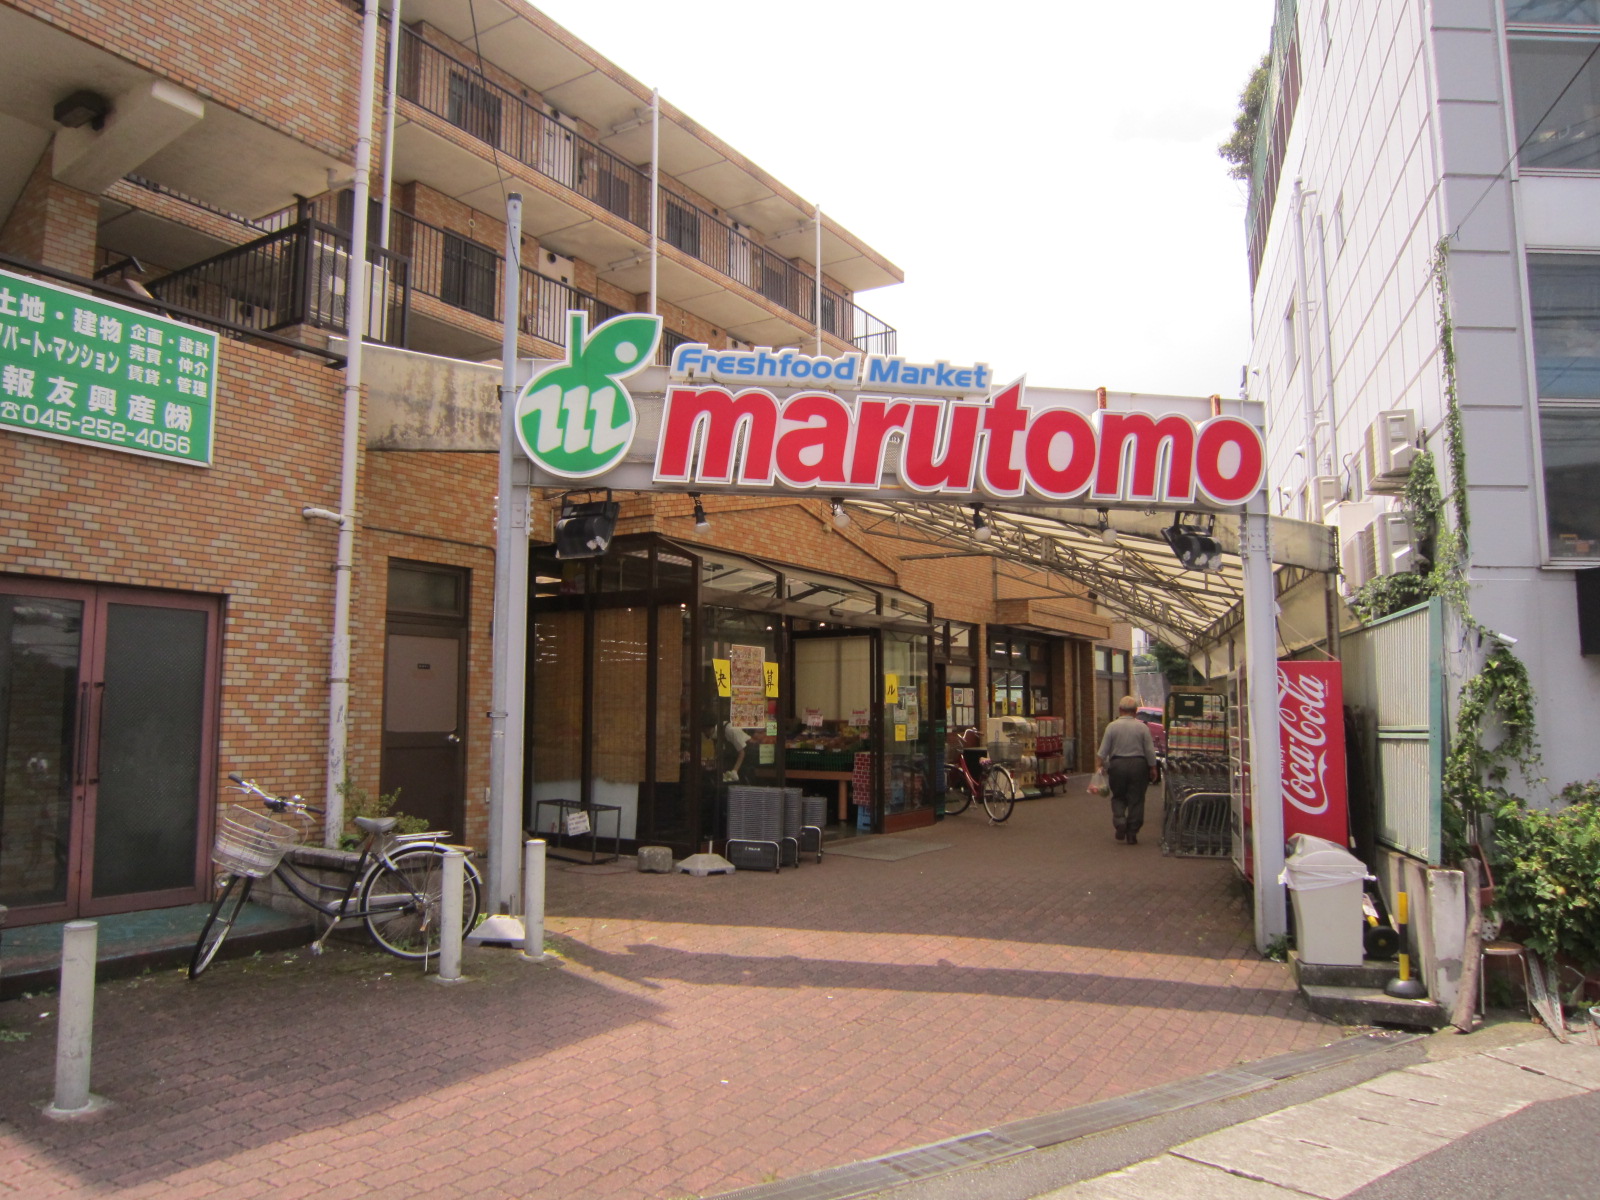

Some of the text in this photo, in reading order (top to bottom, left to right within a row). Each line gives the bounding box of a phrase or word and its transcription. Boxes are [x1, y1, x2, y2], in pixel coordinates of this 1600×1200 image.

[0, 322, 120, 374] パート・マンション
[676, 349, 988, 388] Freshfood Market
[22, 404, 191, 454] 045-252-4056
[657, 376, 1263, 502] marutomo
[1277, 666, 1329, 815] Coca-Cola
